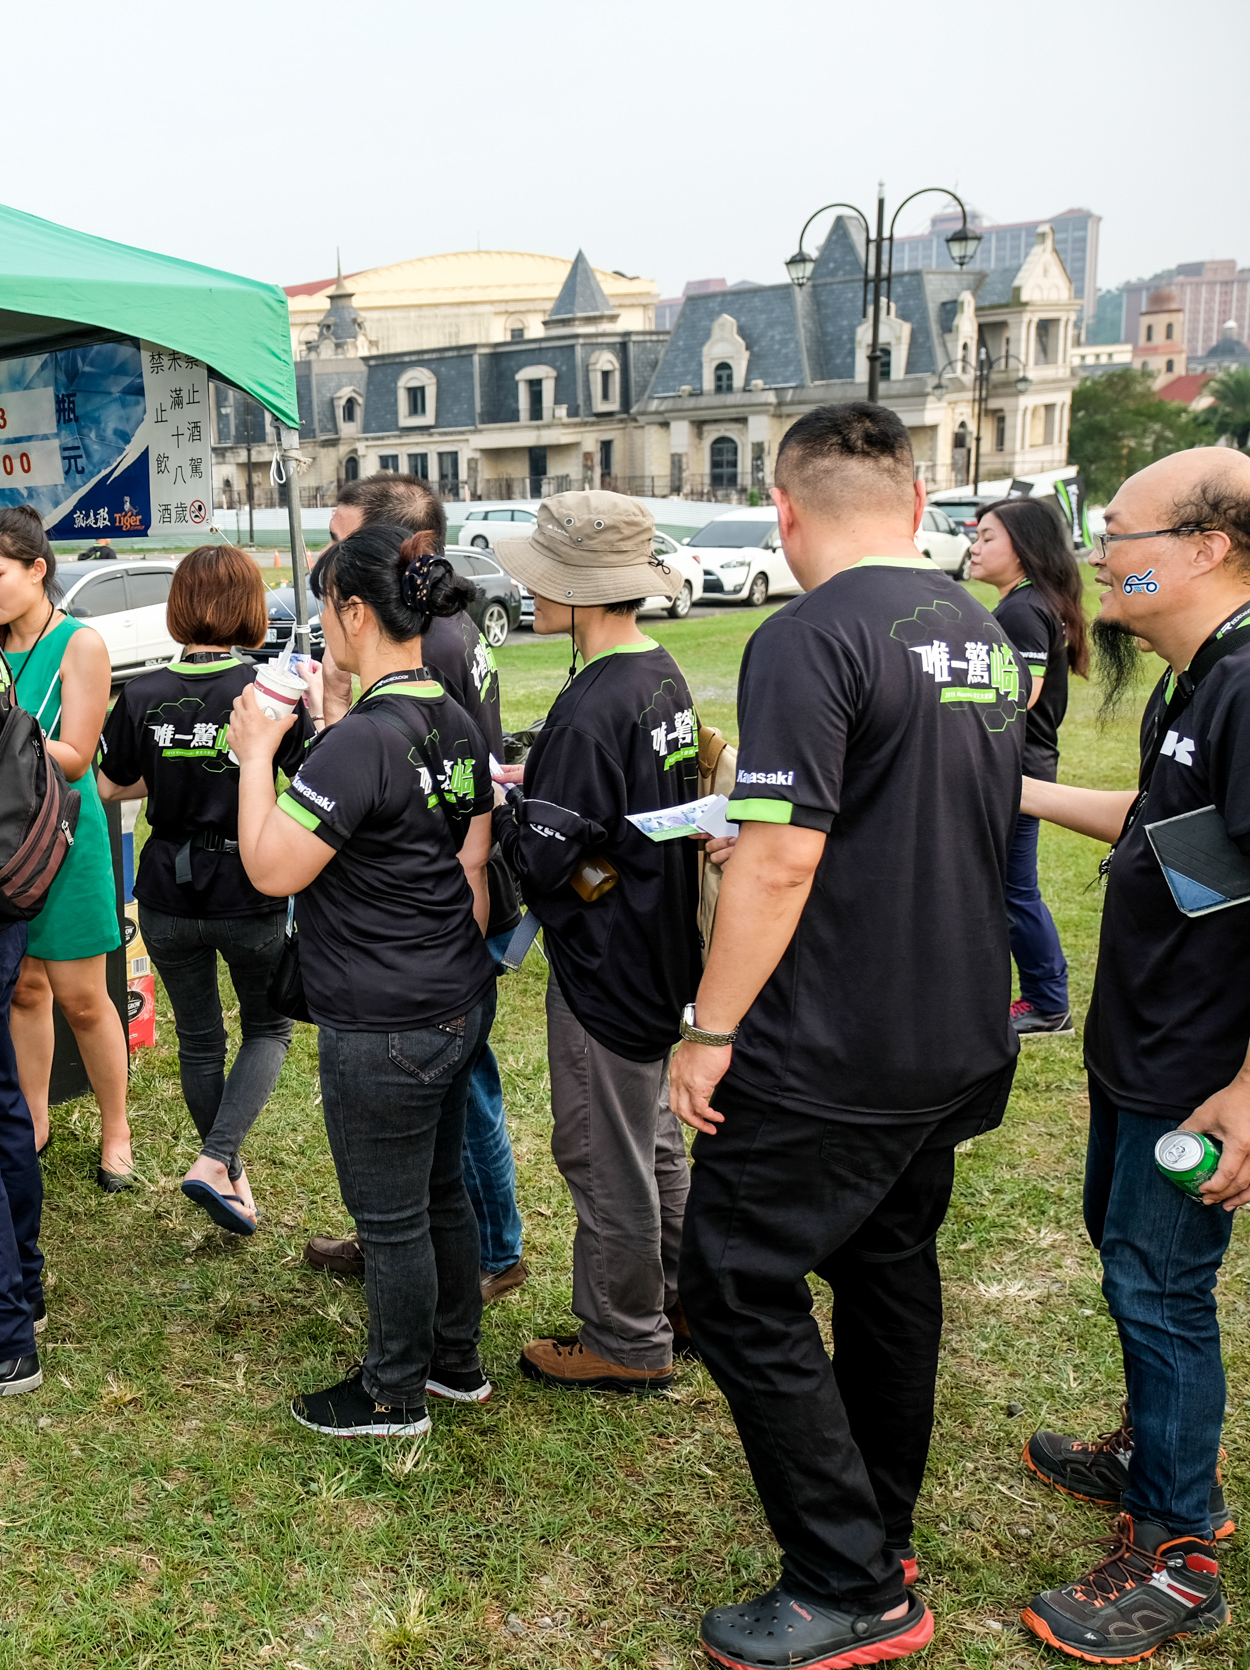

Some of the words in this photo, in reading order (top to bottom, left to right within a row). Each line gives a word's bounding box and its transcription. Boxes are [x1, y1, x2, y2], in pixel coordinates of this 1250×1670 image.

[56, 392, 79, 425] 瓶
[149, 352, 172, 525] 禁止飲酒
[62, 445, 85, 476] 元
[114, 511, 143, 531] Tiger
